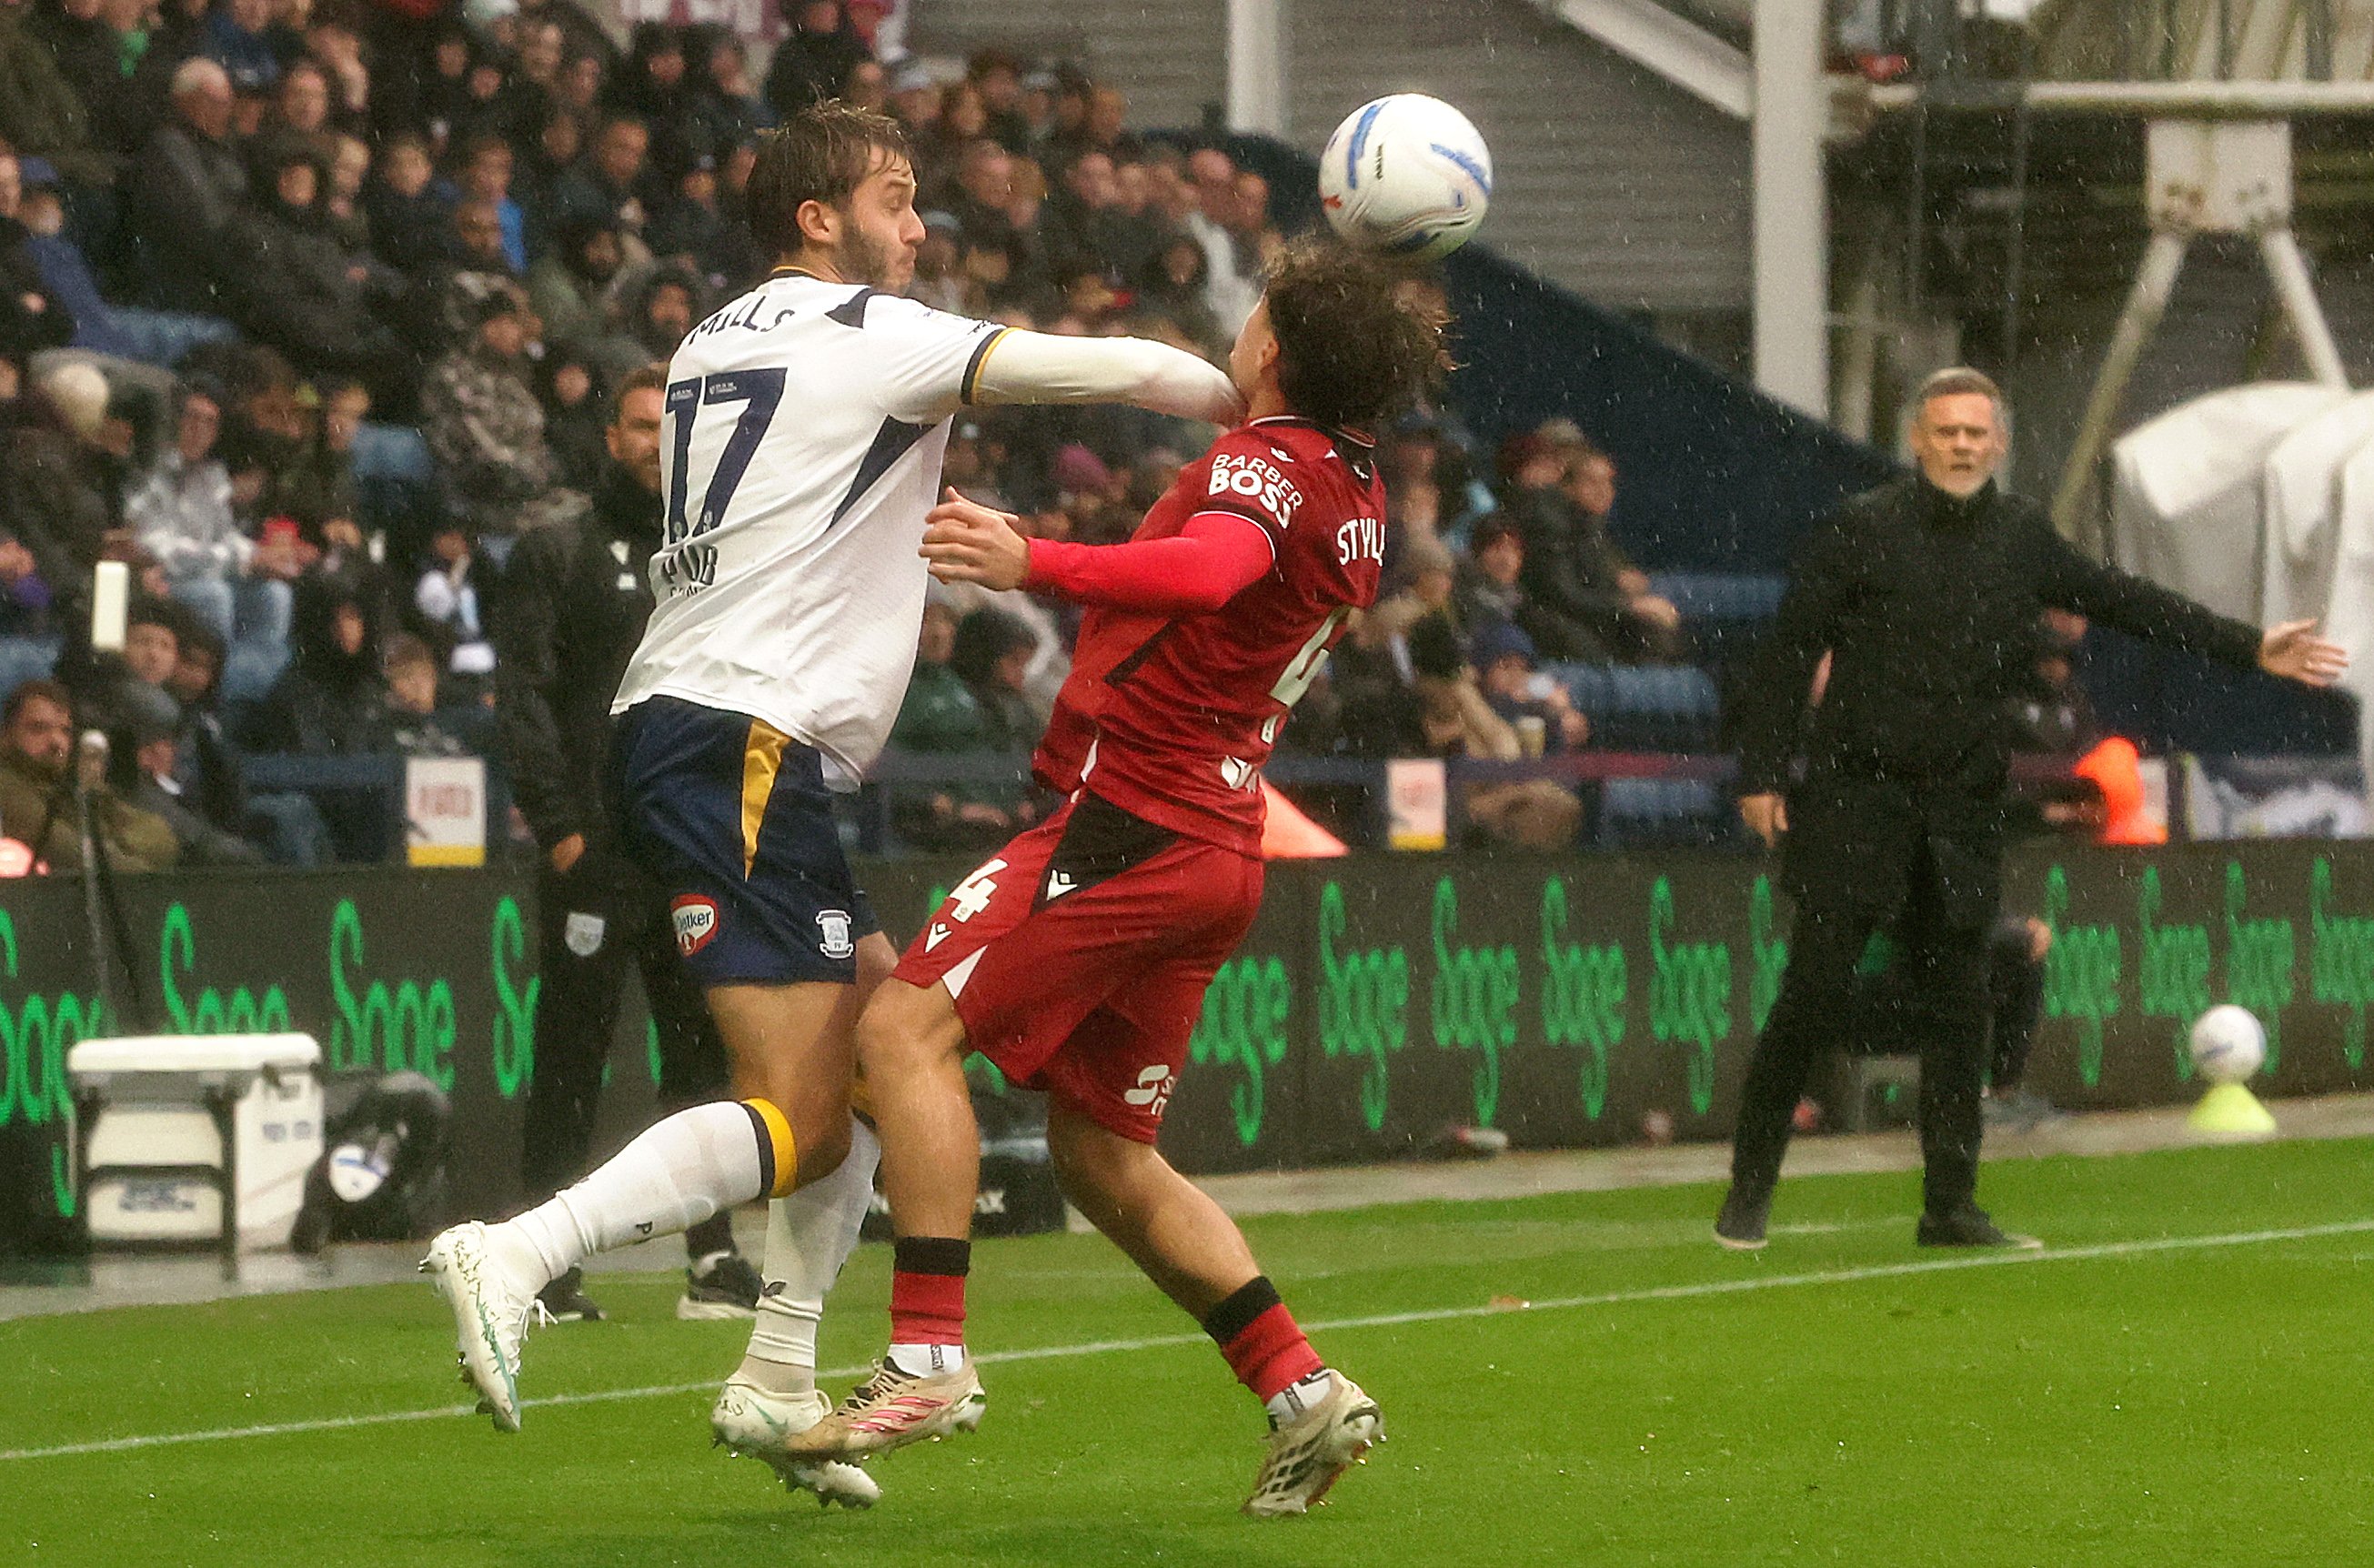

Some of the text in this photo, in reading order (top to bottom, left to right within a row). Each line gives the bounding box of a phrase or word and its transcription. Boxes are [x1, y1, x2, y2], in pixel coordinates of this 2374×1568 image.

[689, 296, 795, 346] MILLS
[665, 367, 789, 544] 17
[1208, 468, 1293, 530] BOSS
[1212, 453, 1303, 512] BARBER
[949, 858, 1009, 923] 4
[1319, 880, 1409, 1130] Sage
[1432, 876, 1519, 1129] Sage
[1541, 875, 1627, 1120] Sage
[1649, 875, 1732, 1114] Sage
